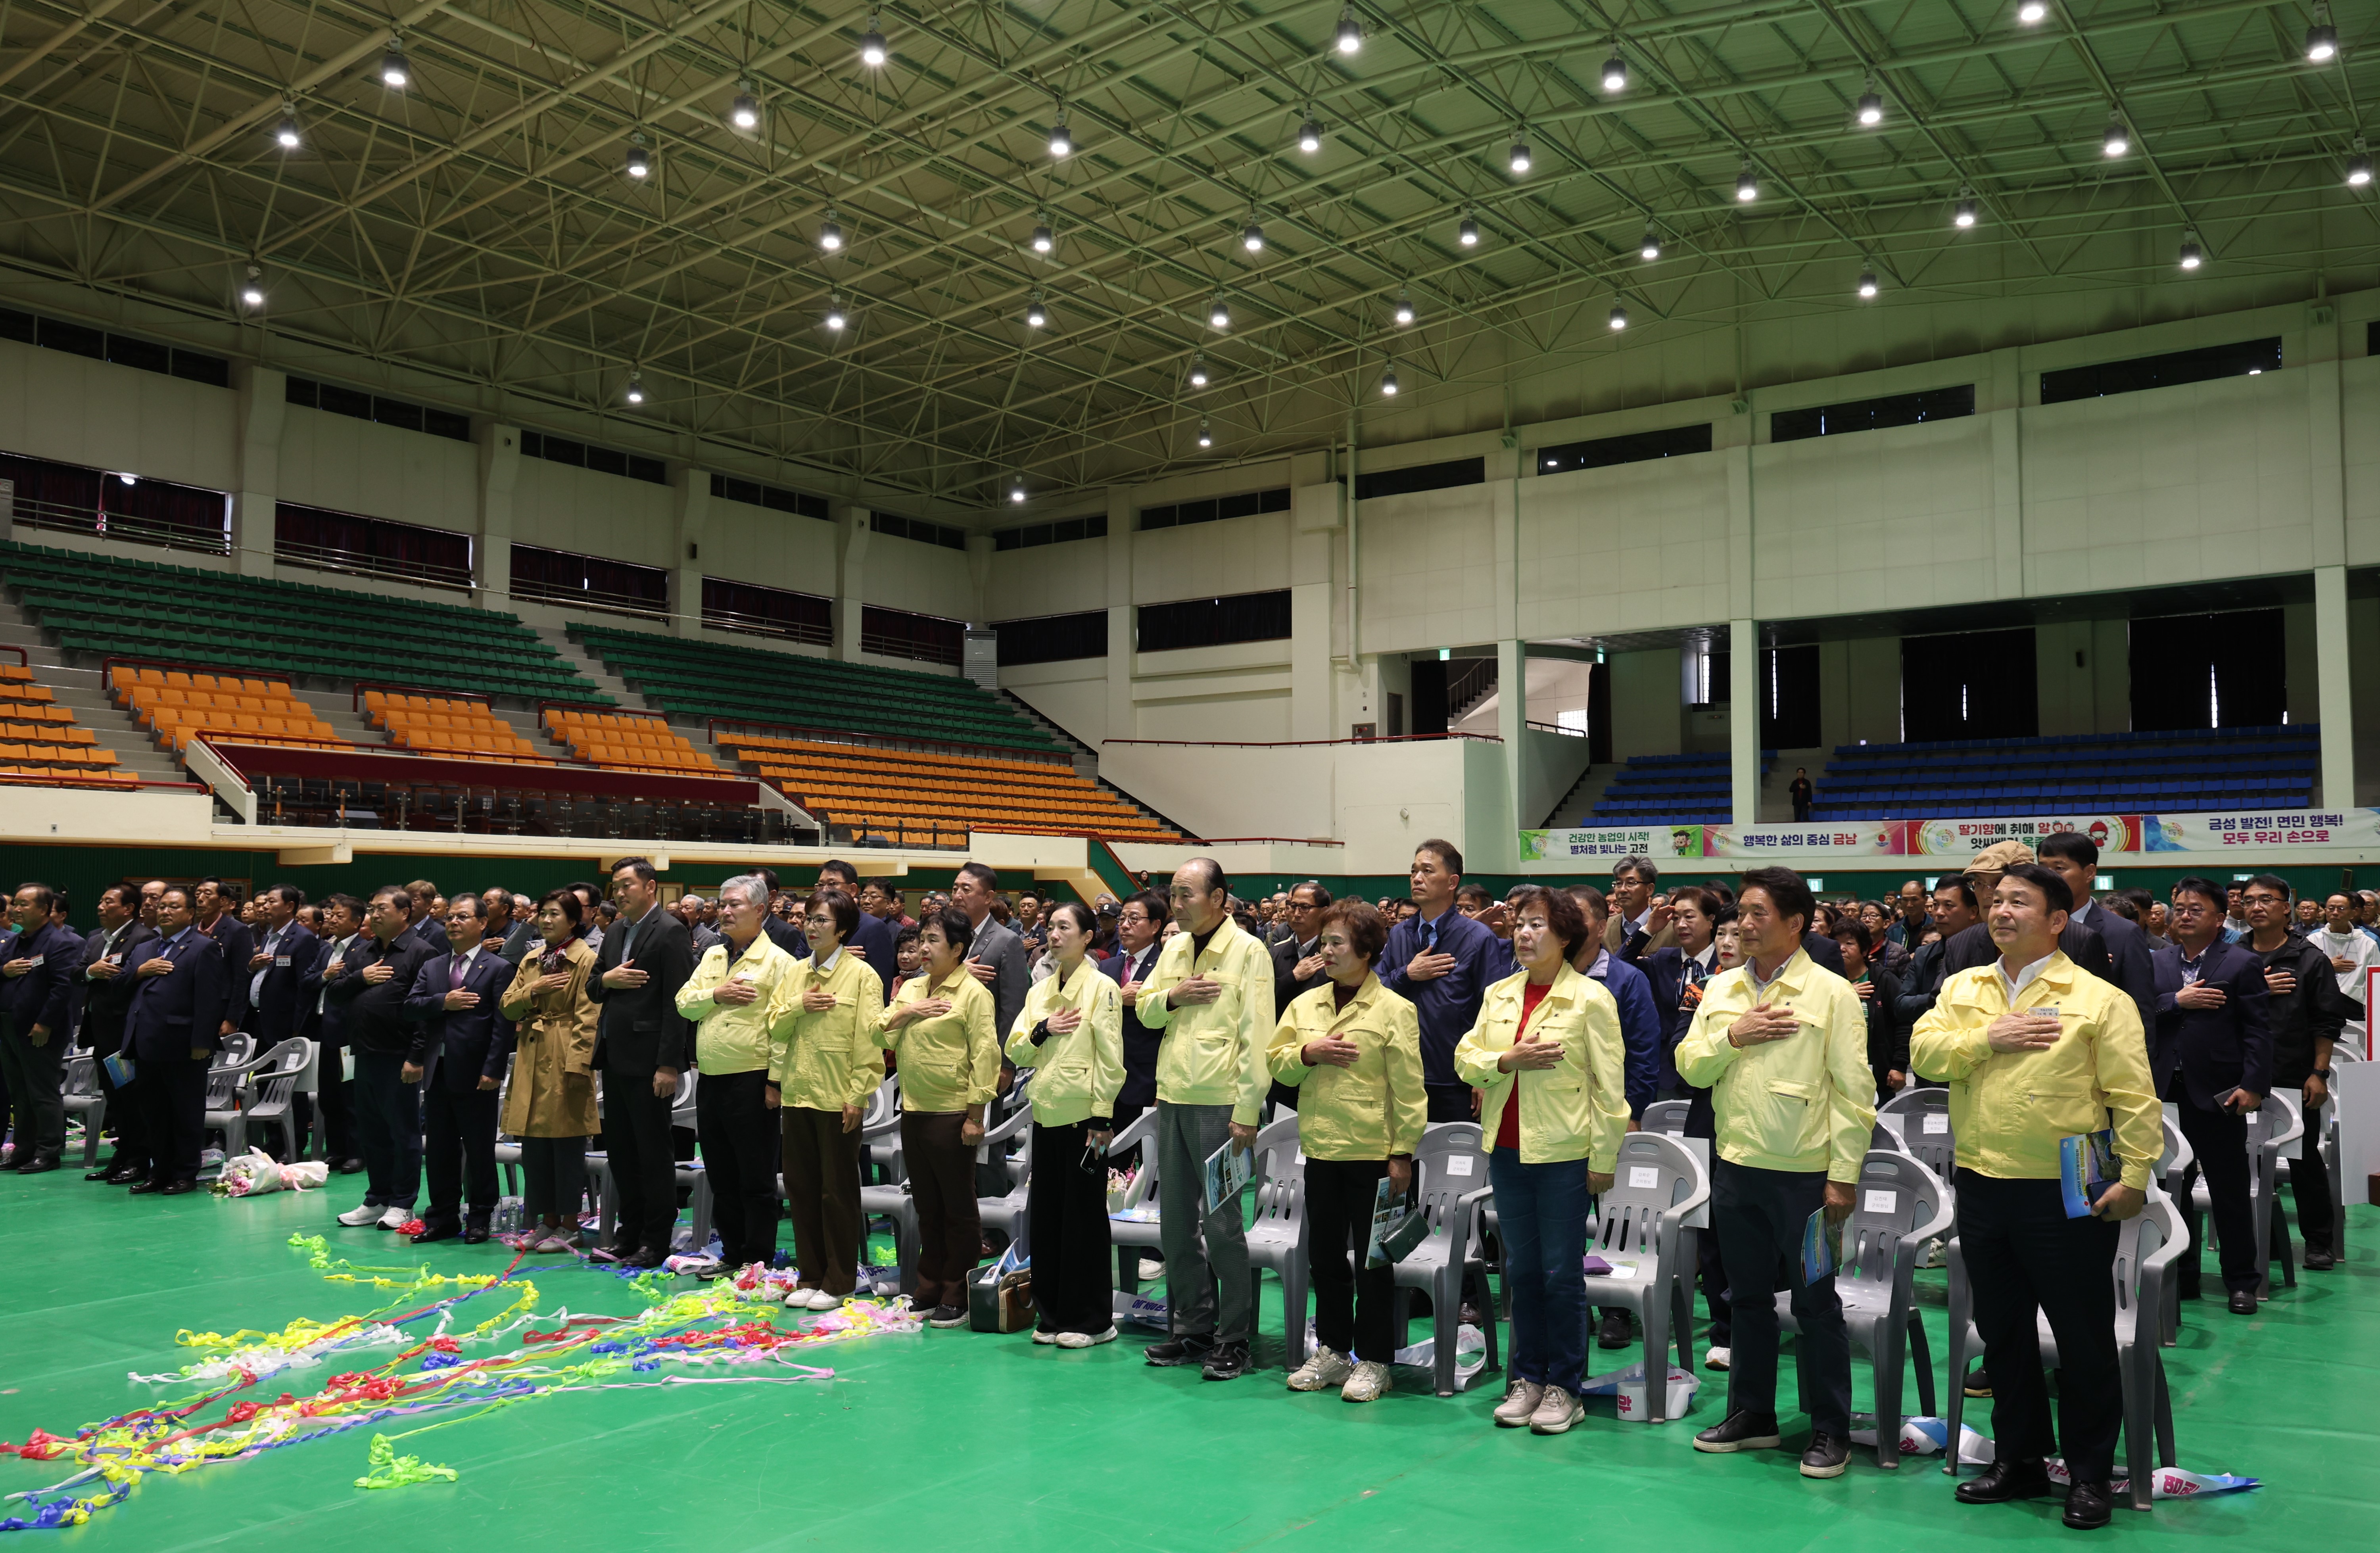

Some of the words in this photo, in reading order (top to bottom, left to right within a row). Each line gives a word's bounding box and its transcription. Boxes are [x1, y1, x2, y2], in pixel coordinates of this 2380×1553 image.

[1959, 824, 2006, 836] 딸기향에
[2010, 822, 2034, 834] 취해
[2038, 822, 2050, 833] 알
[2209, 818, 2236, 830] 금성
[2240, 817, 2272, 829] 발전!
[2277, 815, 2305, 828] 면민
[2309, 814, 2343, 827] 행복!
[1569, 833, 1595, 843] 건강한
[1598, 832, 1625, 842] 농업의
[1628, 831, 1649, 841] 시작!
[1743, 835, 1777, 847] 행복한
[1781, 834, 1803, 846] 삶의
[1807, 833, 1829, 846] 중심
[1833, 833, 1857, 845] 금남
[2223, 832, 2249, 845] 모두
[2254, 831, 2282, 844] 우리
[2287, 830, 2330, 843] 손으로
[1570, 845, 1597, 855] 별처럼
[1600, 844, 1627, 854] 빛나는
[1630, 843, 1648, 853] 고전
